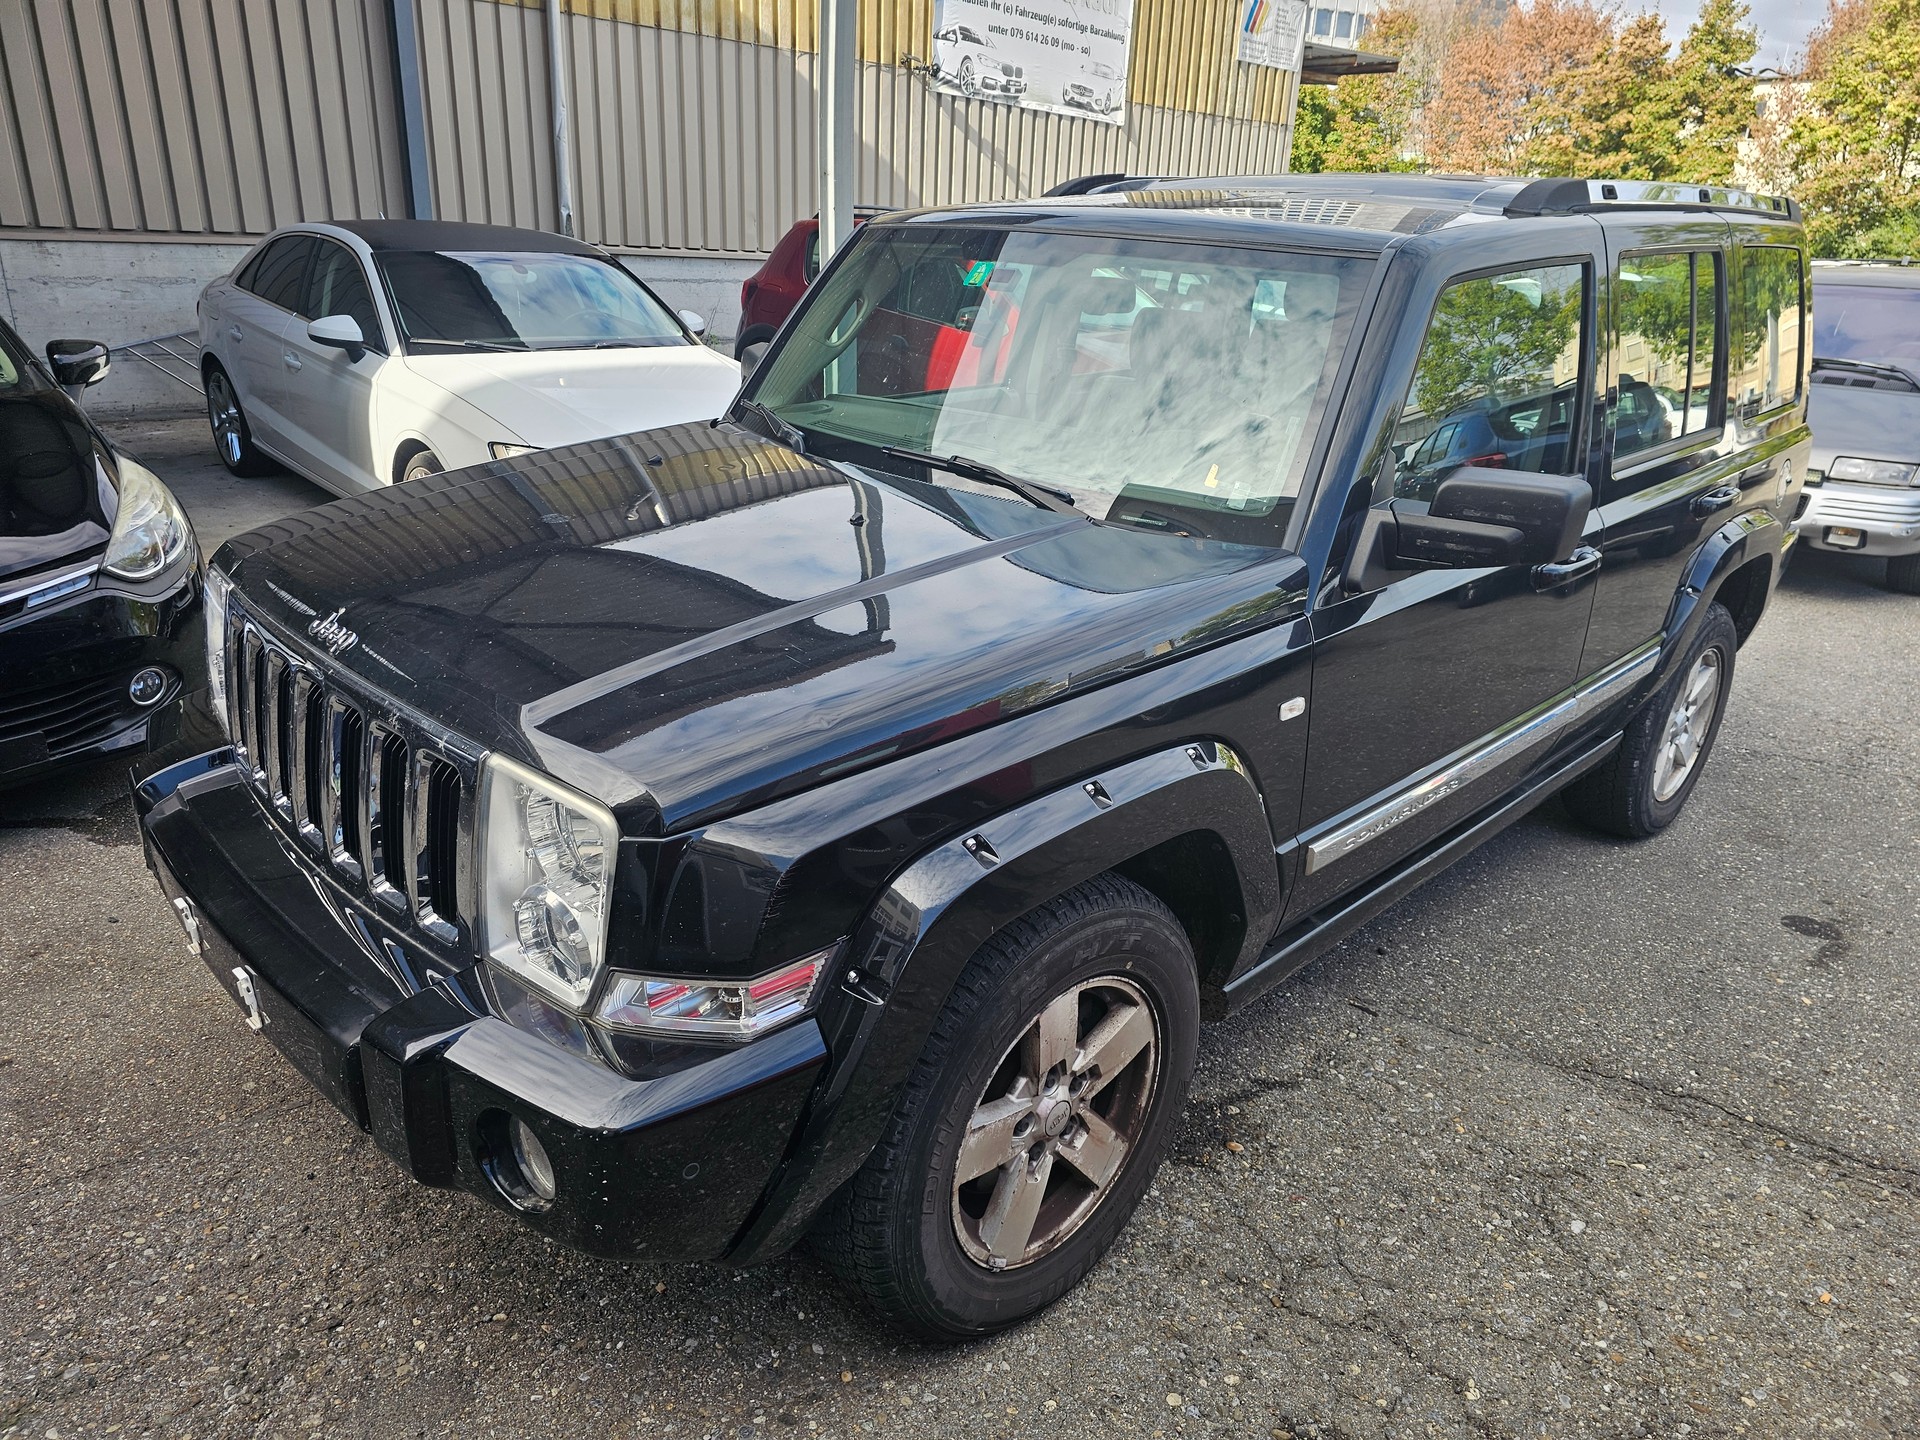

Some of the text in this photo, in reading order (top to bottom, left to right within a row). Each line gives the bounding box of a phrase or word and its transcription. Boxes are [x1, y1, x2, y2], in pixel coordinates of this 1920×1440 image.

[962, 0, 989, 8] ufen
[990, 0, 1001, 11] ihr
[1003, 2, 1013, 16] (e)
[1015, 5, 1057, 27] Fahrzeug(e)
[1058, 17, 1088, 34] sofortige
[1090, 24, 1125, 45] Barzahlung
[988, 24, 1008, 36] unter
[1010, 27, 1024, 39] 079
[1025, 31, 1039, 43] 614
[1040, 34, 1049, 46] 26
[1050, 37, 1060, 48] 09
[1061, 40, 1075, 52] (mo
[1080, 46, 1091, 57] so)
[308, 611, 358, 657] Jeep
